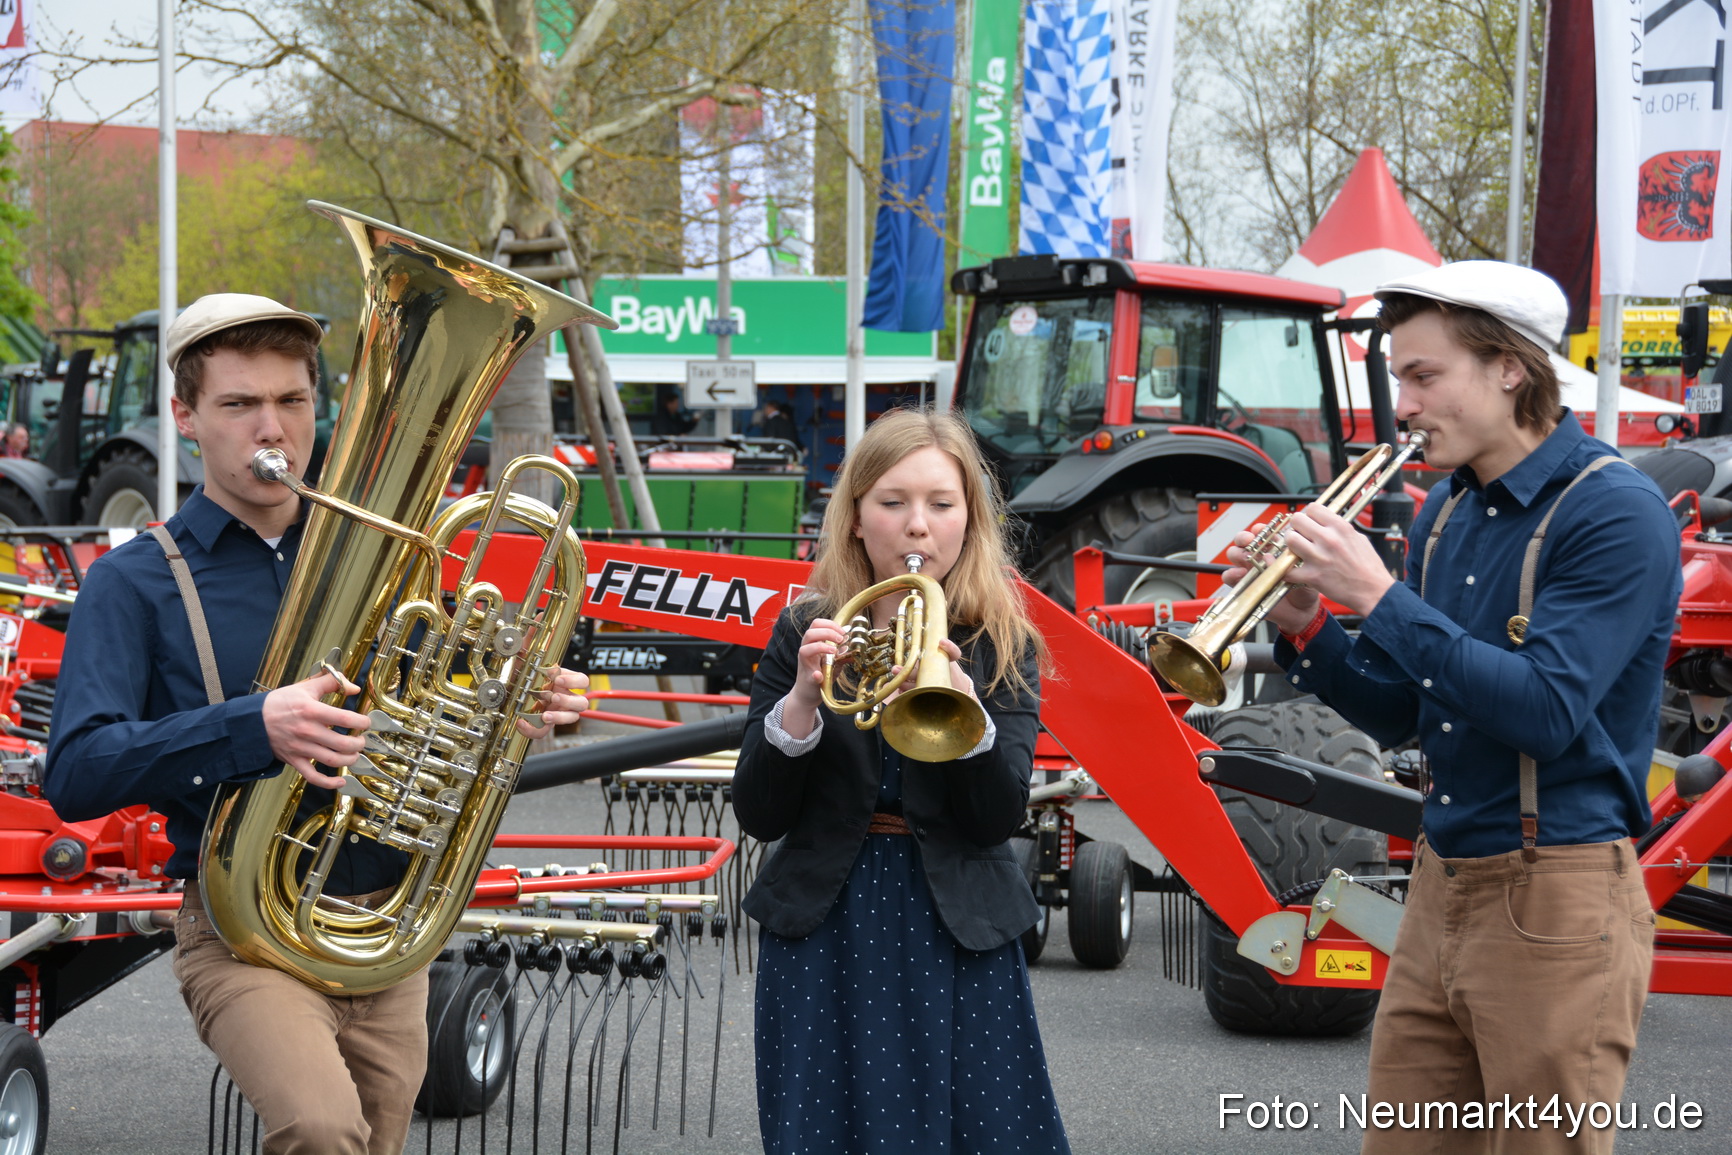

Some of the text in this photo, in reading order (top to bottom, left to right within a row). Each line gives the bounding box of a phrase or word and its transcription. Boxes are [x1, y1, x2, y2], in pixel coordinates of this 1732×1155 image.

[969, 57, 1007, 207] BayWa
[611, 295, 746, 342] BayWa
[691, 366, 716, 379] Taxi
[722, 366, 738, 379] 50
[1696, 400, 1718, 412] 8019
[589, 559, 754, 626] FELLA
[589, 647, 662, 670] FELLA
